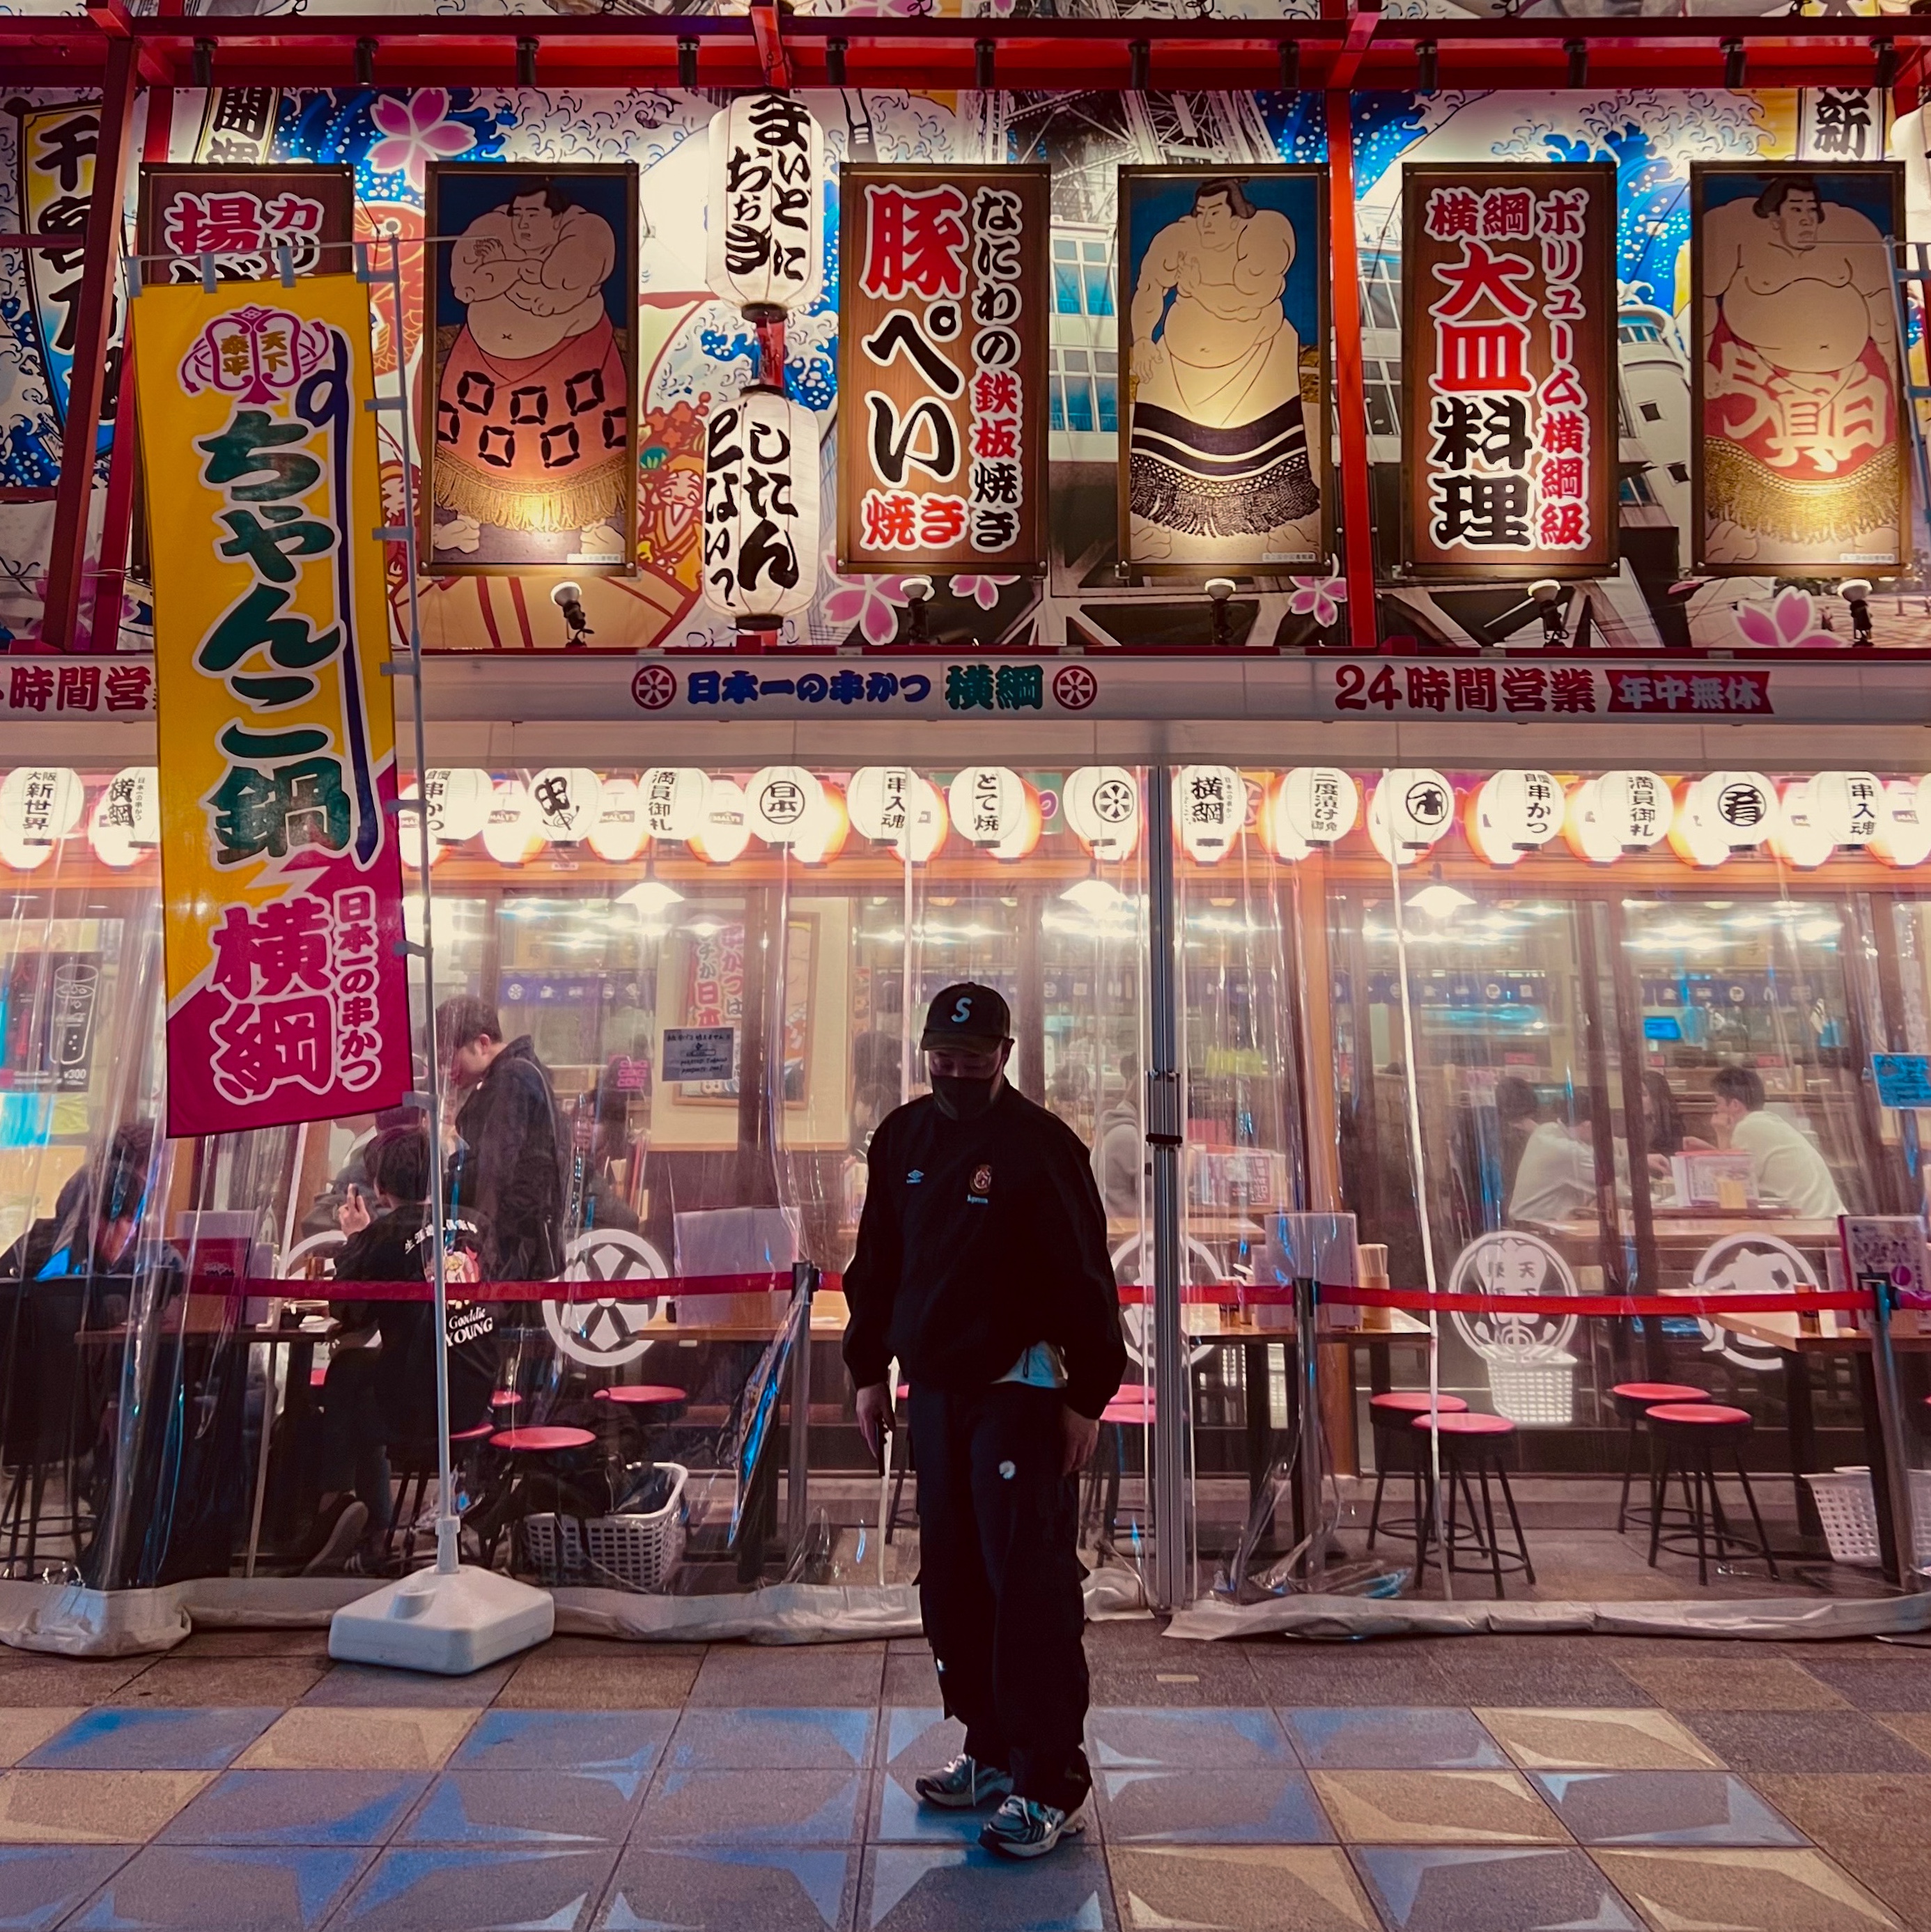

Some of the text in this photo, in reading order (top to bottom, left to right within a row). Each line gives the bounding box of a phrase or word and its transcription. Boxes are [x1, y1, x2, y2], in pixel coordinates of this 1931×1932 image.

[972, 187, 1023, 552] なにわの鉄板焼き
[1537, 187, 1591, 550] ボリューム横綱級
[0, 666, 156, 712] 時間営
[687, 664, 1044, 711] 日本一の串かつ 横綱
[1335, 664, 1762, 713] 24時間営業 年中無休
[108, 777, 135, 828] 横綱
[1190, 776, 1224, 825] 横綱
[210, 896, 334, 1103] 横綱
[334, 887, 381, 1091] 日本一の串かつ
[951, 997, 972, 1022] S
